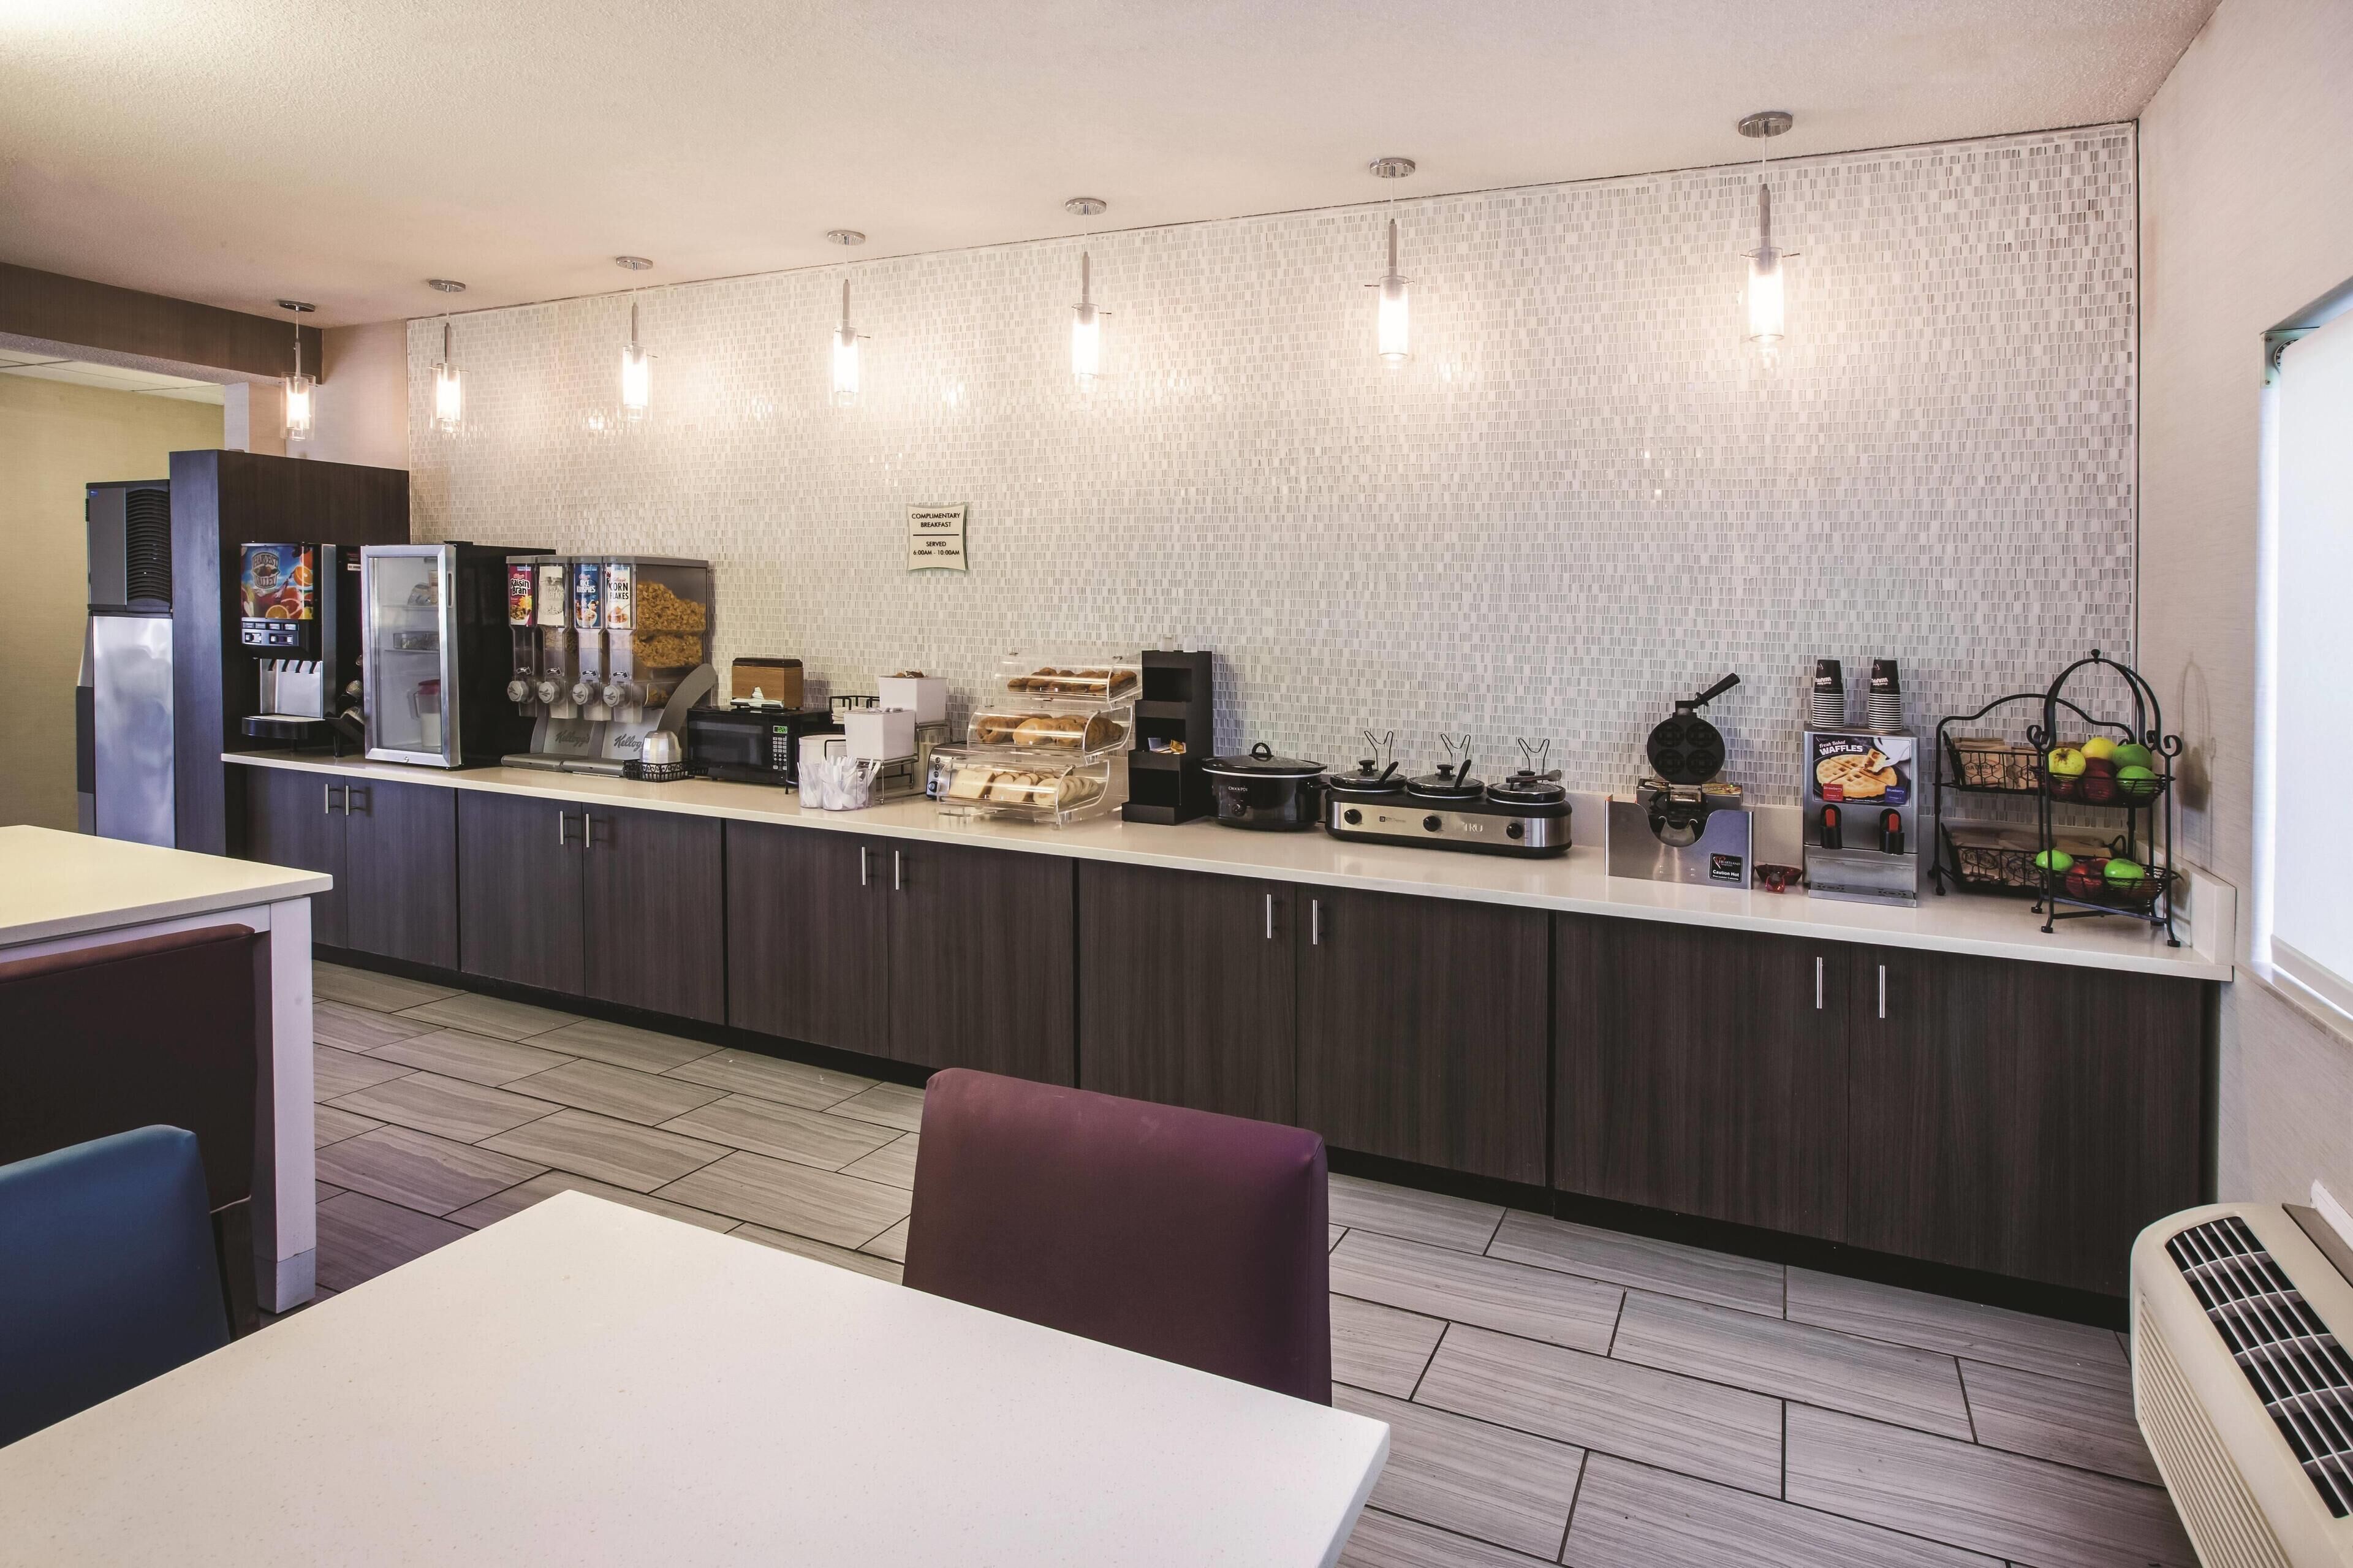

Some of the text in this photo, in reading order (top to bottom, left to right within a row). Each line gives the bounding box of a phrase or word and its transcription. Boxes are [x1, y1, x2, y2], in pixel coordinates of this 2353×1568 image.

[254, 555, 278, 567] HARVEST
[255, 576, 276, 586] VALLEY
[510, 578, 530, 589] Raisin
[610, 582, 628, 591] CORN
[512, 586, 528, 595] Bran
[614, 733, 644, 752] Kellog
[1819, 744, 1863, 756] WAFFLES
